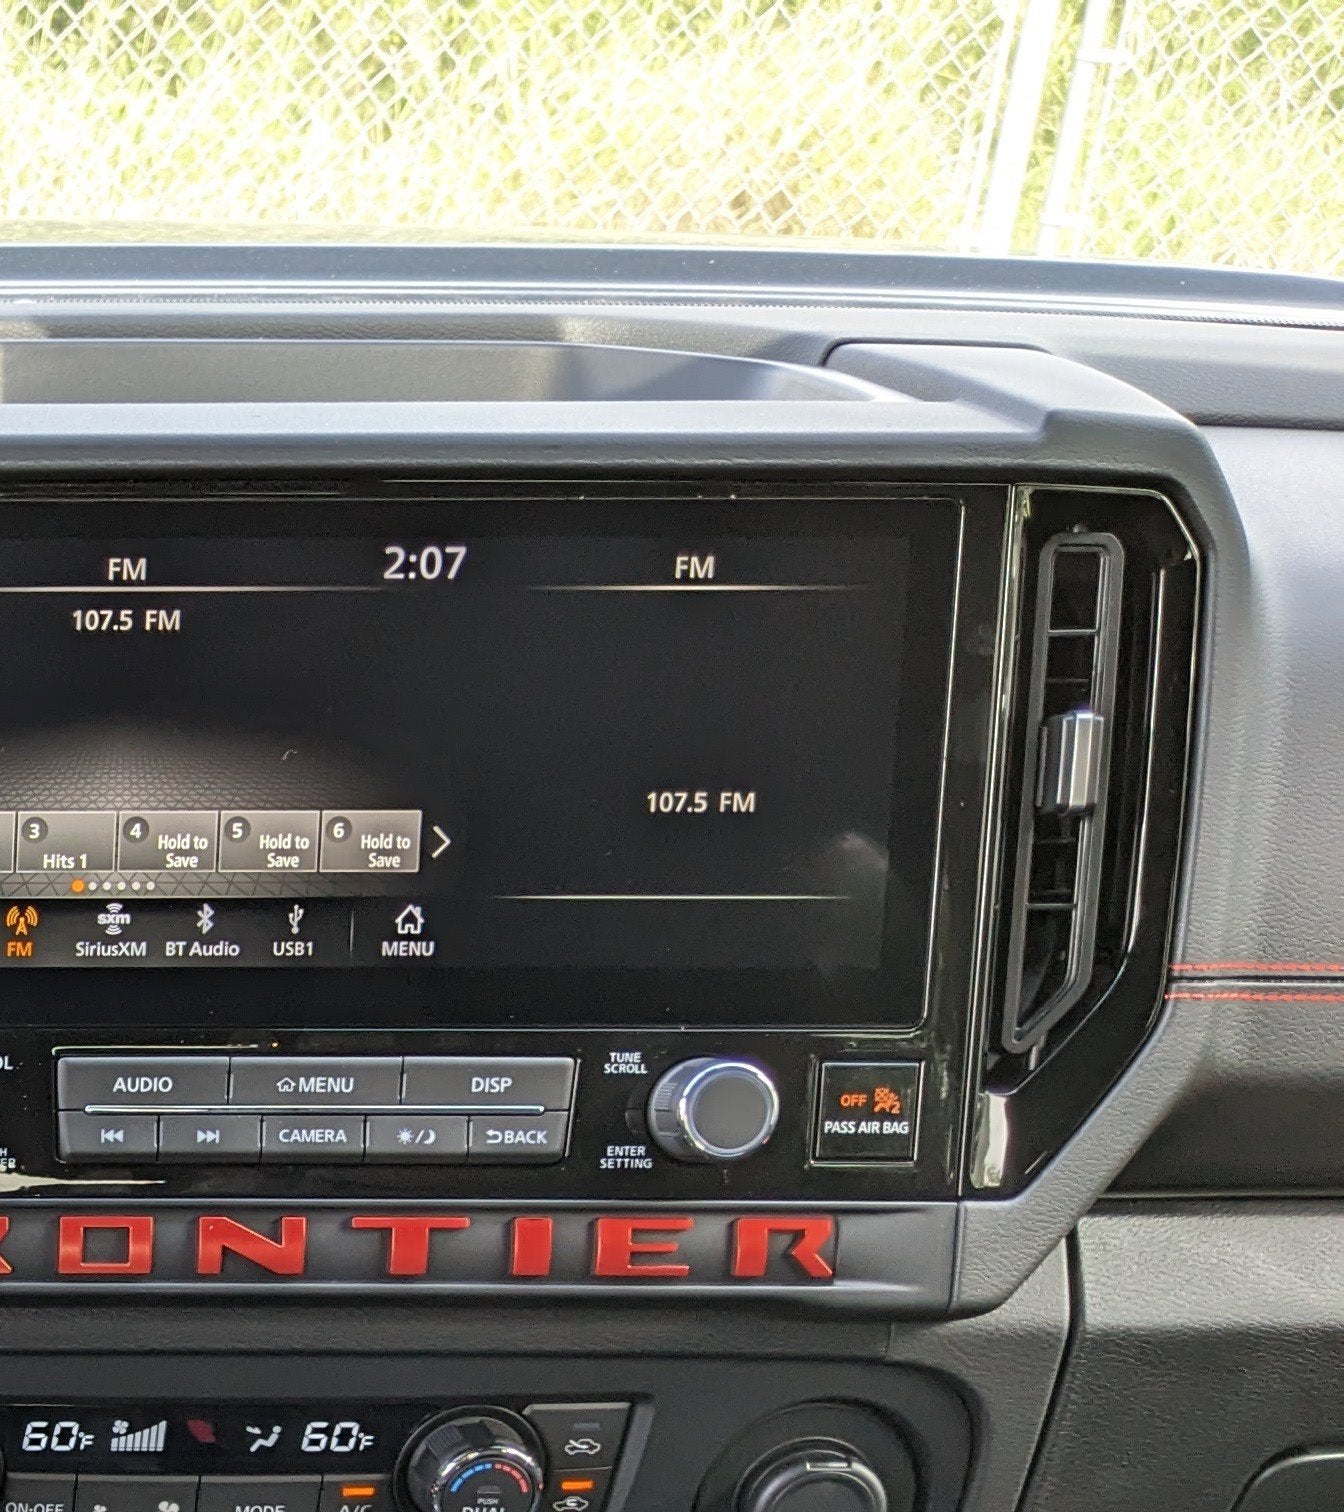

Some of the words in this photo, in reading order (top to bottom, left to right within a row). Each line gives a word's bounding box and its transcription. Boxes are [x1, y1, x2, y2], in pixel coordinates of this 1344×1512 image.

[108, 558, 148, 581] FM
[382, 546, 468, 582] 2:07
[674, 555, 716, 579] FM
[72, 609, 134, 632] 107.5
[145, 609, 182, 632] FM
[645, 792, 708, 814] 107.5
[718, 792, 757, 814] FM
[28, 823, 40, 840] 3
[129, 823, 142, 839] 4
[231, 822, 243, 839] 5
[333, 822, 344, 839] 6
[157, 834, 190, 852] Hold
[193, 836, 209, 852] to
[258, 834, 291, 852] Hold
[294, 836, 310, 852] to
[360, 833, 392, 851] Hold
[395, 835, 412, 851] to
[43, 852, 76, 869] Hits
[79, 853, 88, 869] 1
[164, 852, 199, 869] Save
[266, 852, 300, 869] Save
[367, 852, 401, 869] Save
[6, 942, 33, 958] FM
[75, 941, 148, 958] SiriusXM
[164, 942, 185, 958] BT
[187, 941, 241, 958] Audio
[272, 942, 315, 958] USB1
[381, 941, 436, 958] MENU
[608, 1053, 642, 1065] TUNE
[603, 1062, 648, 1075] SCROLL
[113, 1076, 174, 1094] AUDIO
[298, 1077, 355, 1094] MENU
[470, 1076, 512, 1094] DISP
[840, 1094, 868, 1107] OFF
[278, 1128, 347, 1145] CAMERA
[504, 1128, 548, 1145] BACK
[823, 1121, 855, 1135] PASS
[858, 1121, 880, 1135] AIR
[883, 1121, 910, 1135] BAG
[606, 1145, 647, 1158] ENTER
[599, 1157, 653, 1171] SETTING
